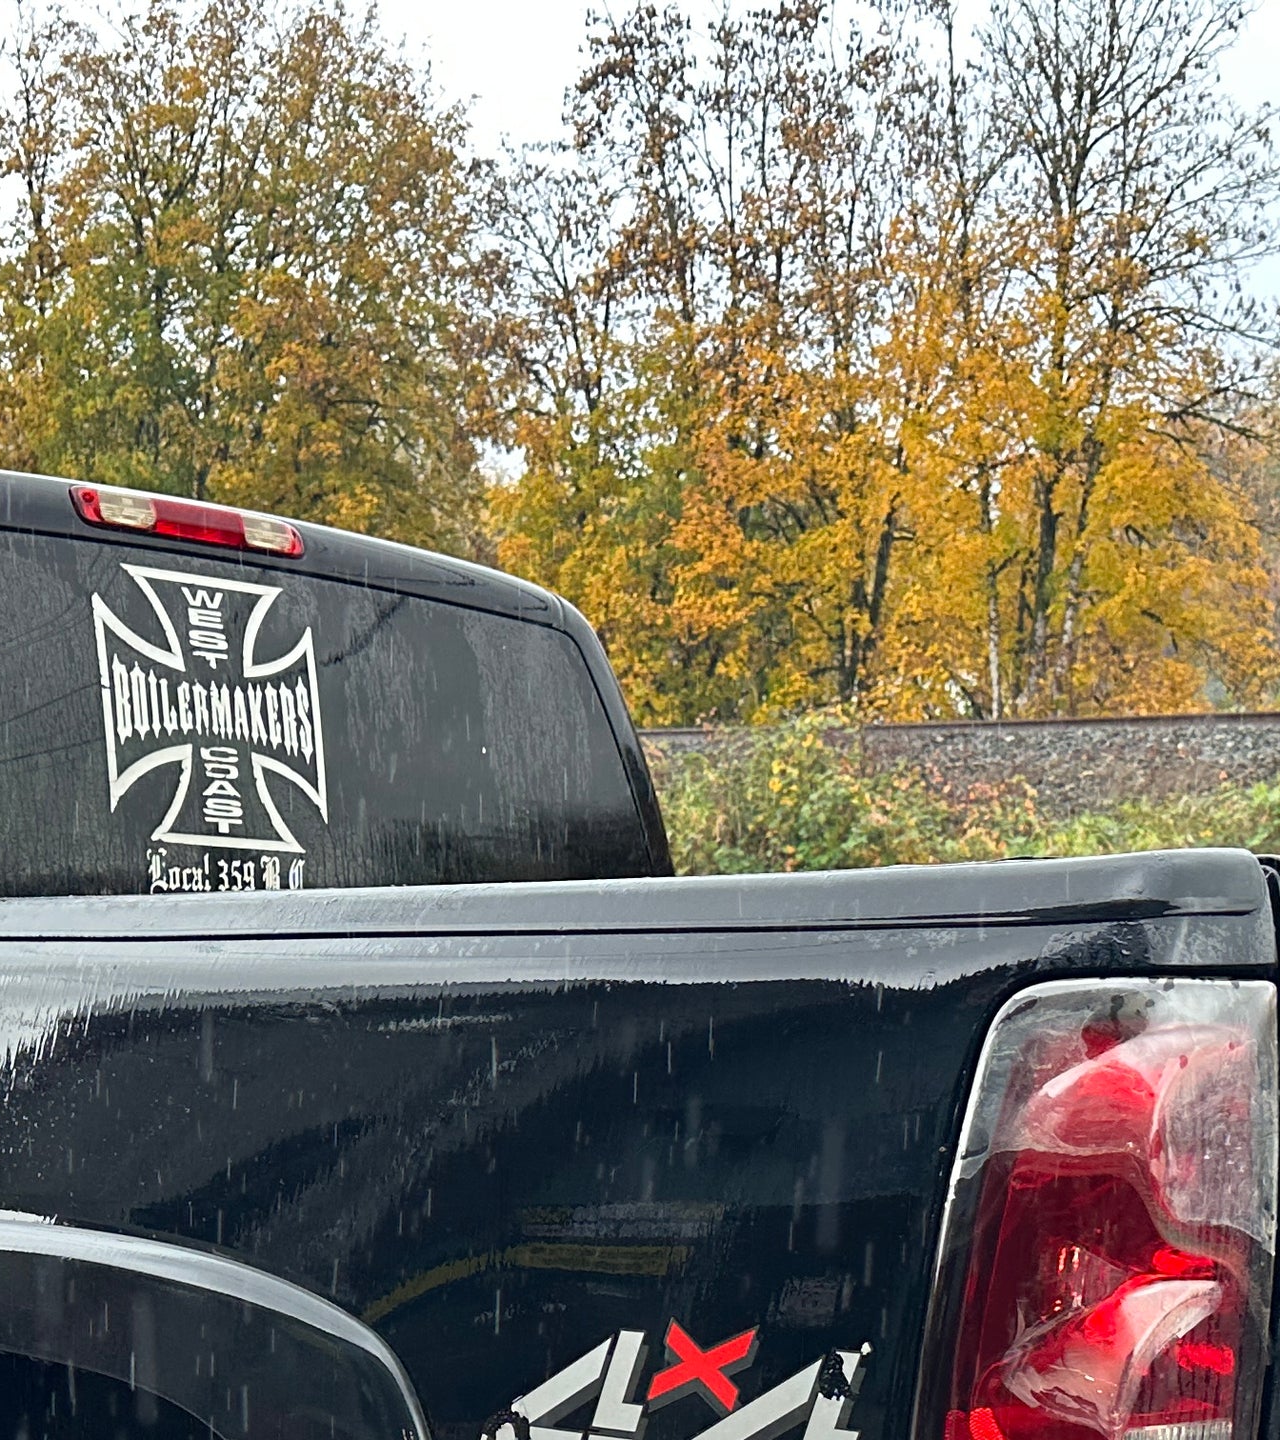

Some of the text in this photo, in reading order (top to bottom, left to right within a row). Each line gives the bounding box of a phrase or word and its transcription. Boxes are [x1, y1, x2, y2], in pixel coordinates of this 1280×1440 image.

[181, 586, 229, 670] WEST
[112, 652, 314, 766] BOILERMAKERS
[200, 746, 244, 834] COAST
[146, 847, 212, 895] Local
[217, 858, 256, 892] 359
